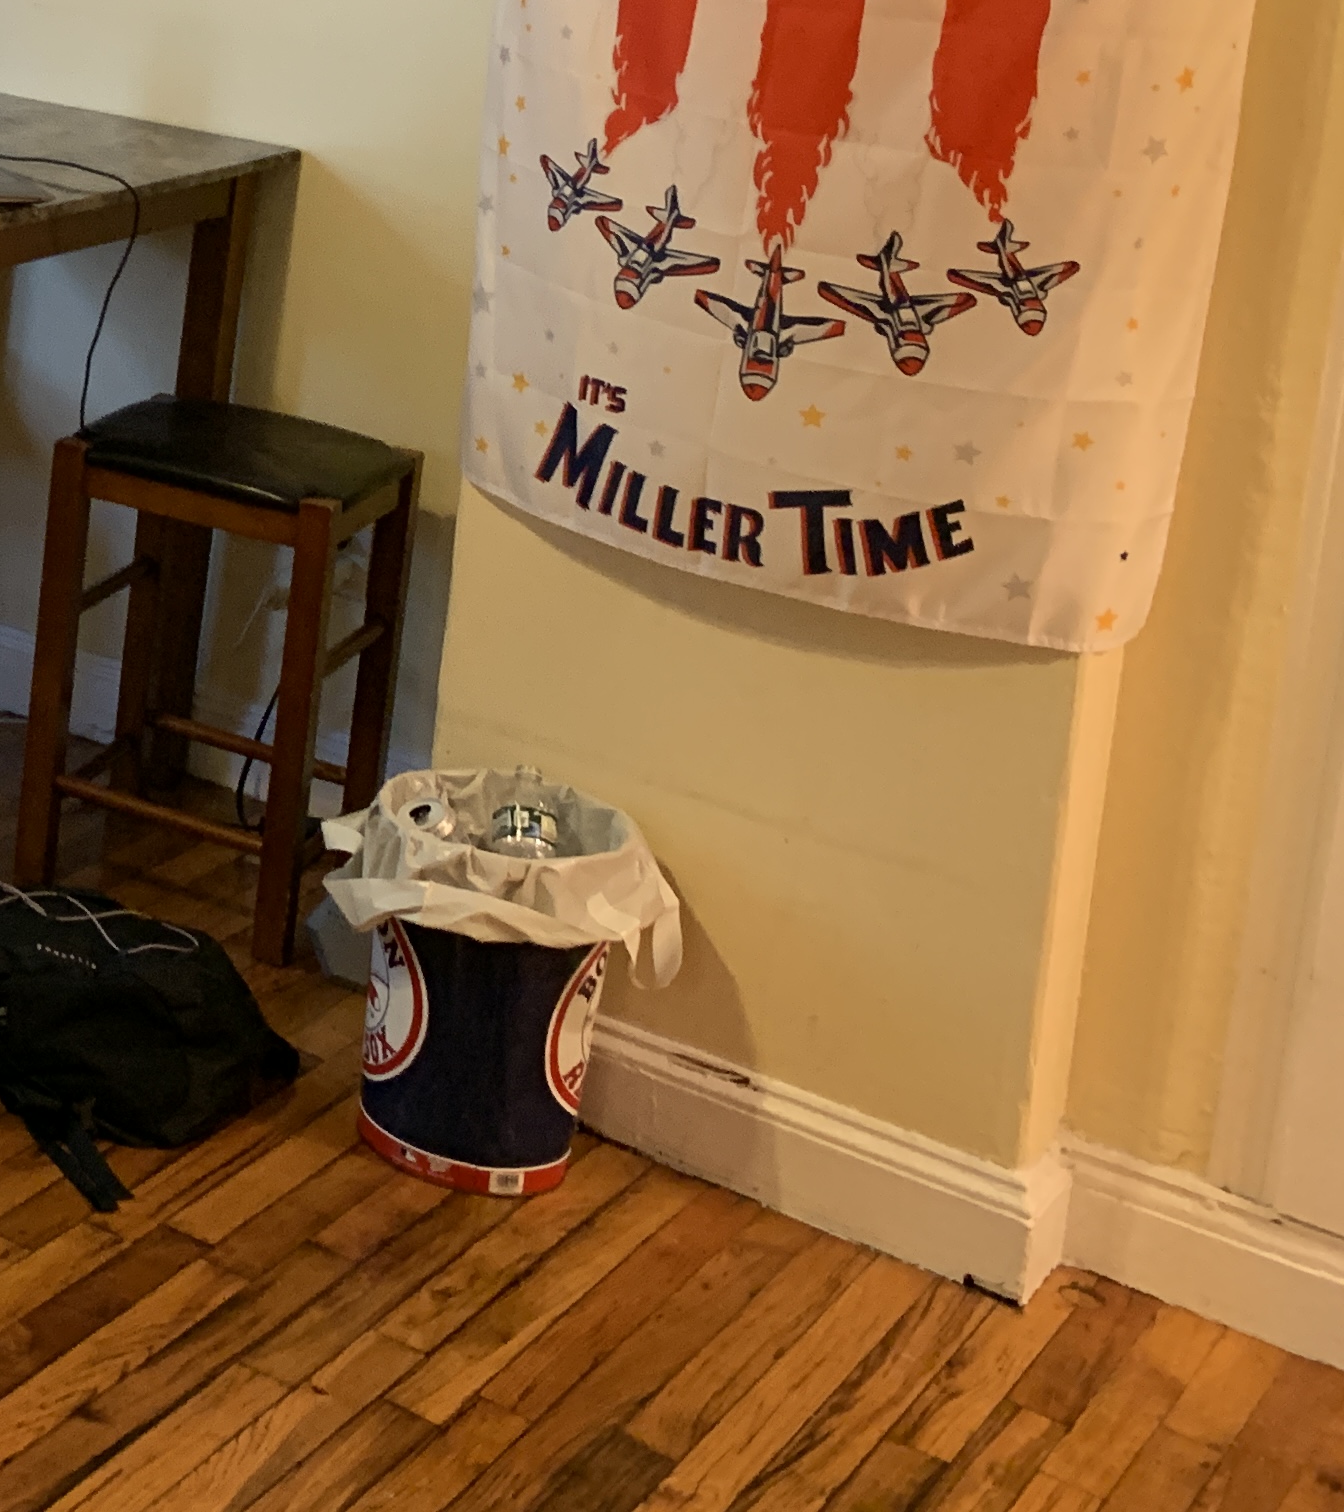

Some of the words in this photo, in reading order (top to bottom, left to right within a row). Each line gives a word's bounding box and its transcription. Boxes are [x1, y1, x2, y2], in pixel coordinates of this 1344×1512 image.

[577, 375, 628, 414] IT'S
[534, 401, 765, 568] MILLER
[768, 489, 975, 577] TIME
